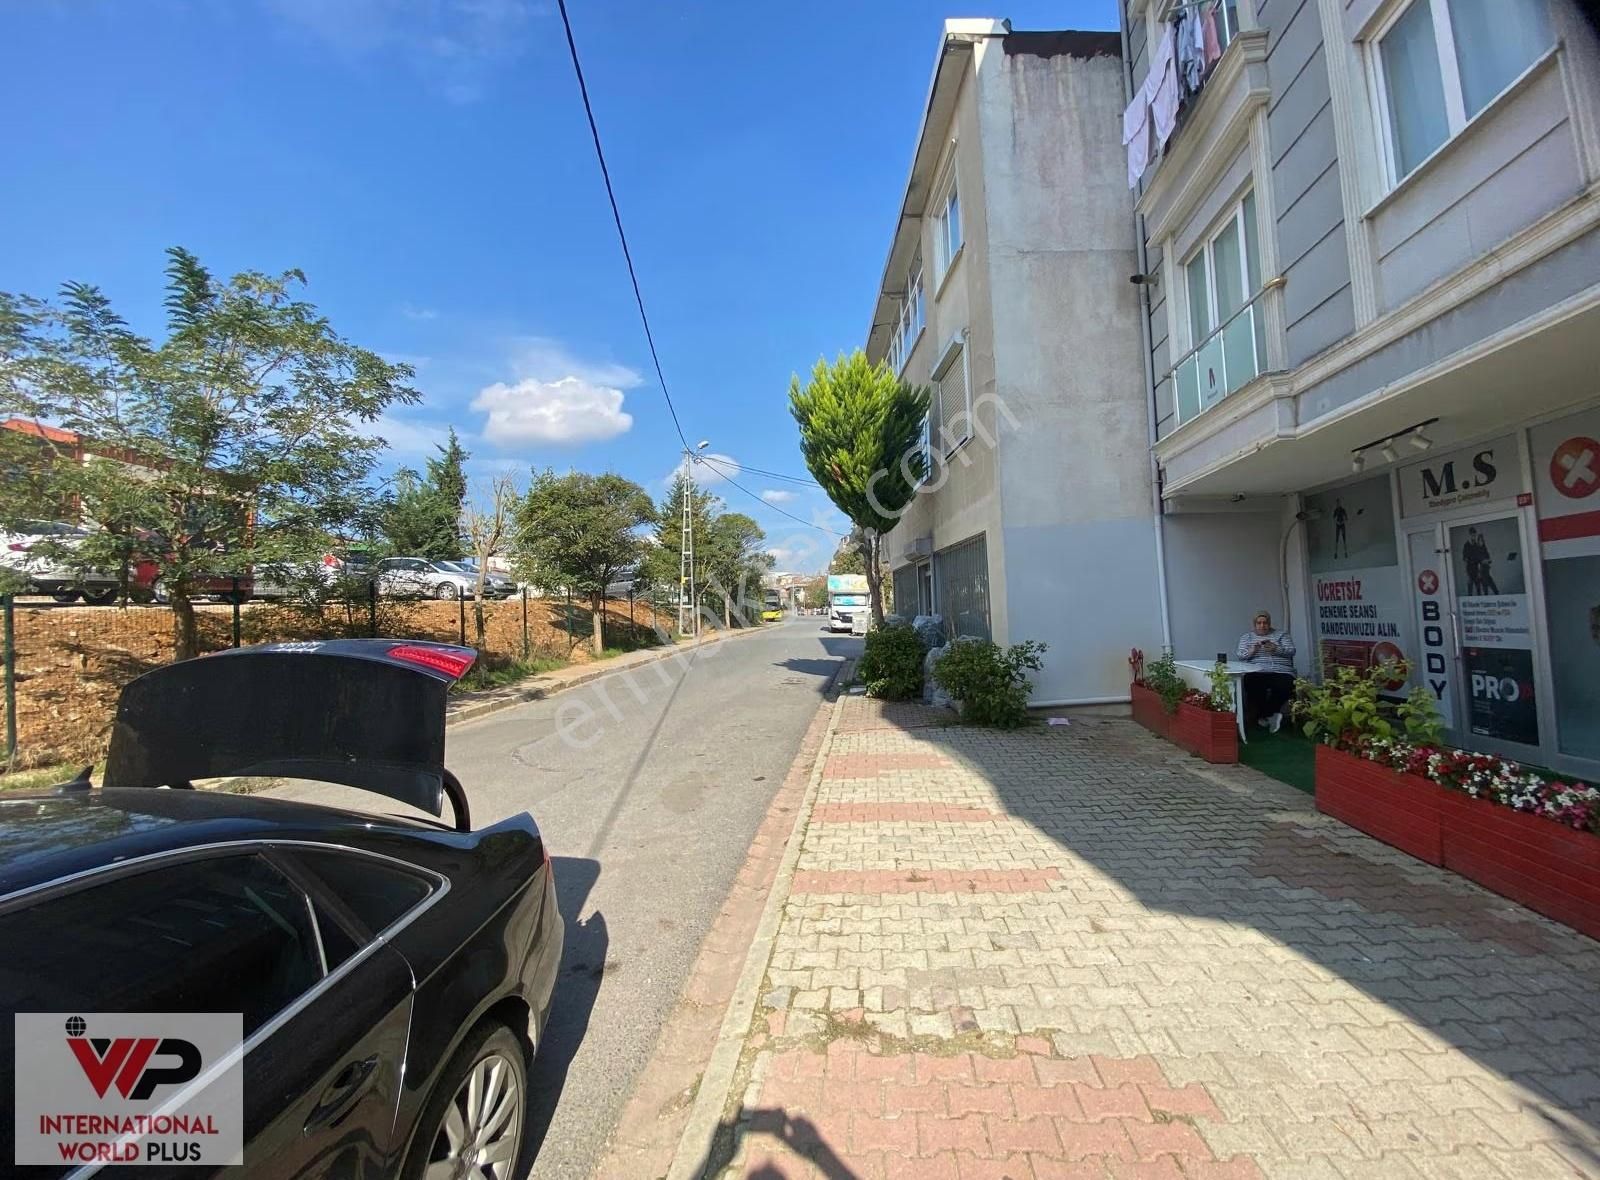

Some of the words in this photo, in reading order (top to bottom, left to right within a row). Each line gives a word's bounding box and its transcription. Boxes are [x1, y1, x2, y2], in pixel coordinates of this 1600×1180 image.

[1420, 450, 1497, 499] M.S
[1317, 576, 1362, 601] ÜCRETSİZ
[1319, 604, 1348, 620] DENEME
[1349, 604, 1378, 619] SEANSI
